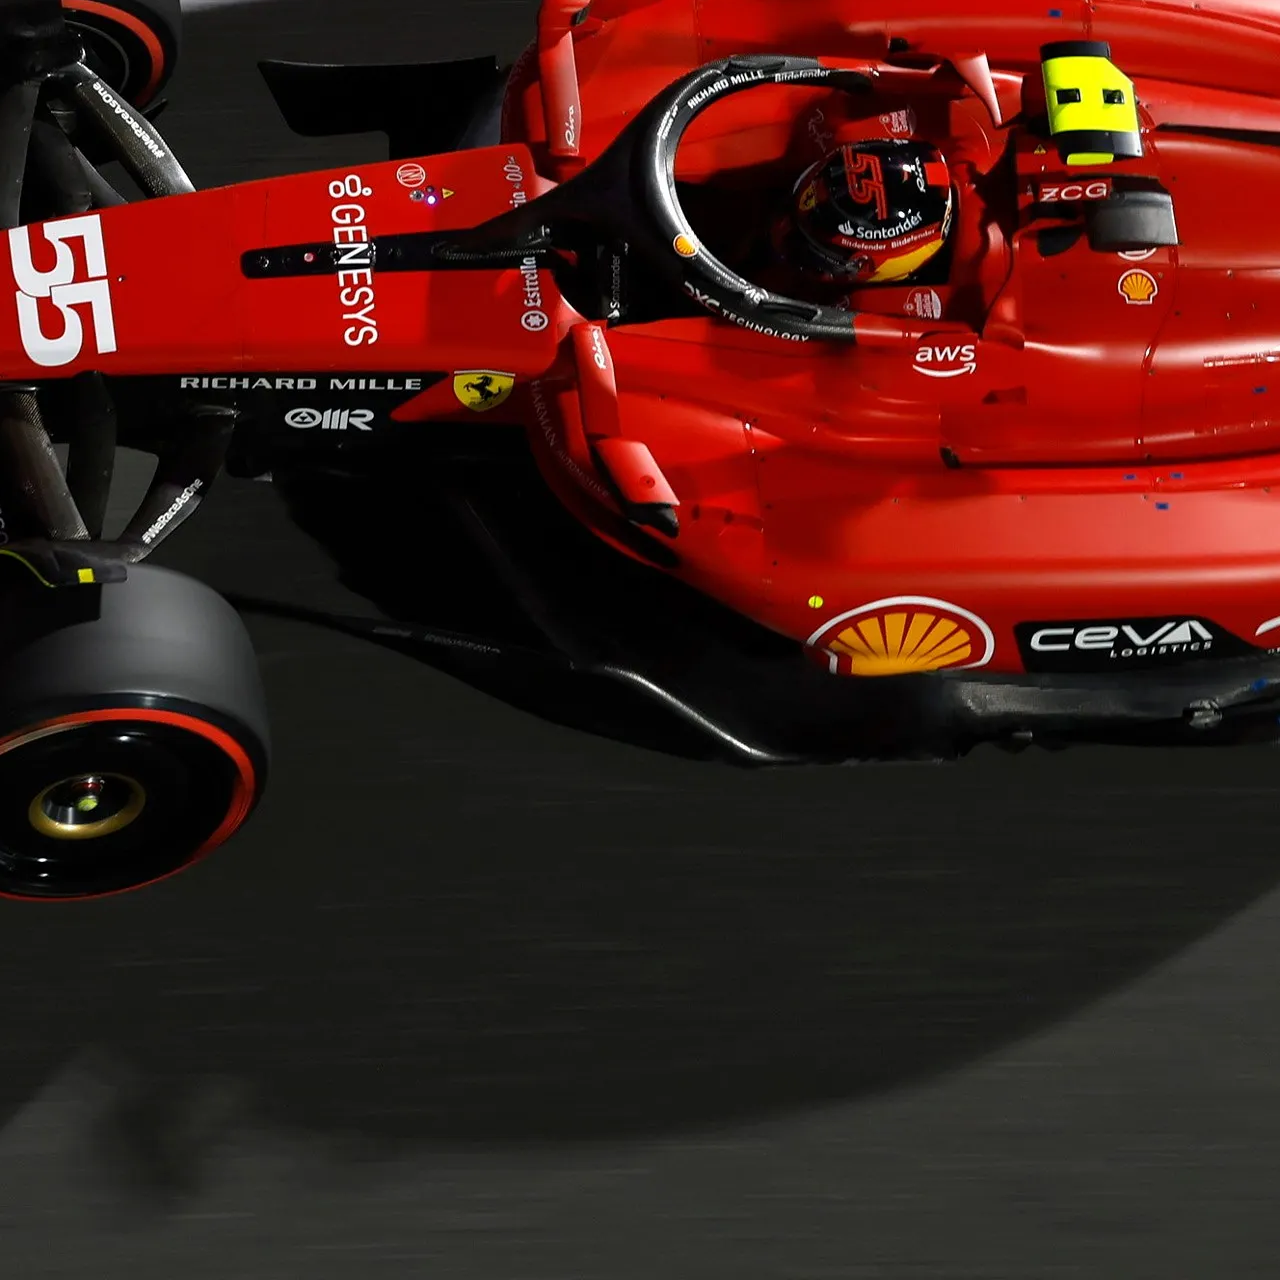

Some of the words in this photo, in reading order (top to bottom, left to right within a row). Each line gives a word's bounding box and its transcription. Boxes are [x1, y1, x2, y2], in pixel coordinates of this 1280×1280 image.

[688, 78, 729, 110] RICHARD
[730, 70, 765, 86] MILLE
[93, 82, 165, 158] #WeRaceAsOne
[1040, 183, 1107, 202] ZCG
[856, 212, 923, 240] Santander
[8, 214, 118, 367] 55
[331, 205, 378, 346] GENESYS
[520, 257, 542, 307] Estrella
[723, 309, 809, 343] TECHNOLOGY
[914, 344, 976, 365] aws
[180, 376, 317, 391] RICHARD
[330, 377, 422, 390] MILLE
[141, 478, 204, 544] #WeRaceAsOne
[1109, 640, 1212, 658] LOGISTICS
